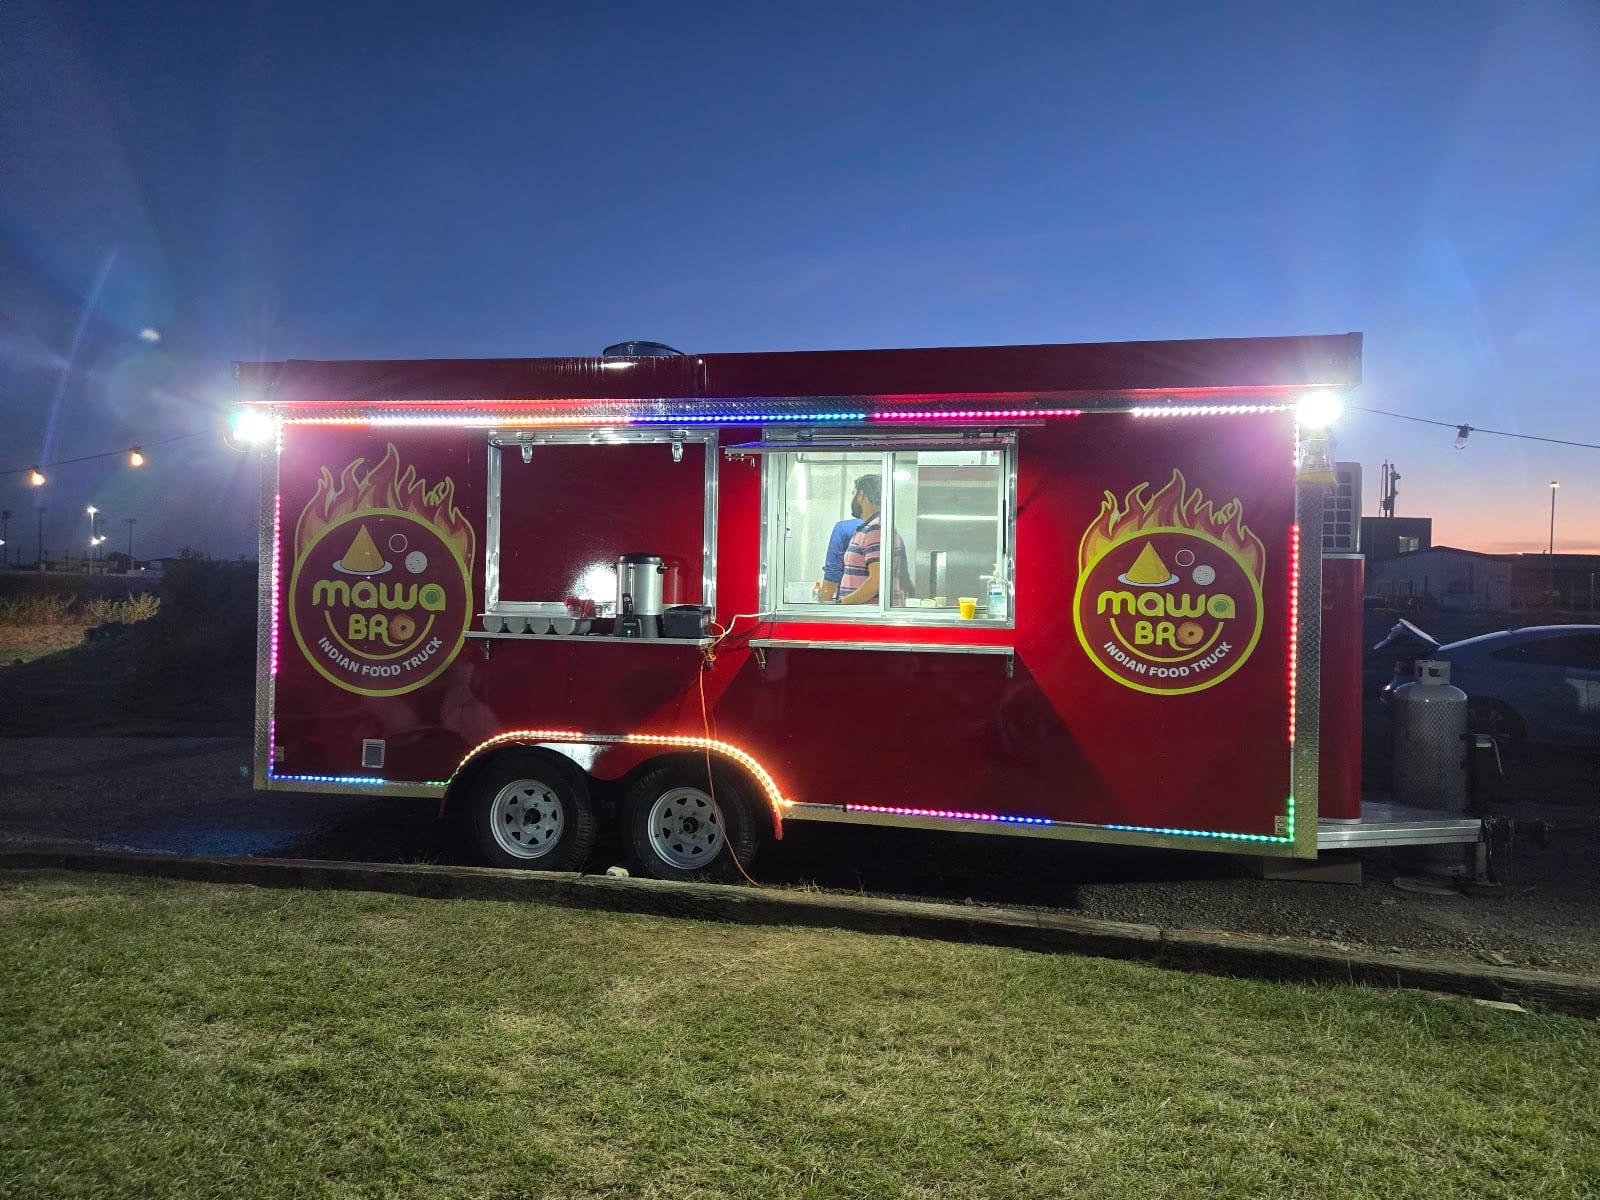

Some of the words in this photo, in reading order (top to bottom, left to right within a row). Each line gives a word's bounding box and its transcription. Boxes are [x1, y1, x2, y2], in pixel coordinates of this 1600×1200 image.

[312, 579, 446, 611] mawa
[1097, 590, 1236, 619] mawa
[348, 613, 416, 647] BRO
[1134, 620, 1204, 651] BRO
[317, 636, 359, 672] INDIAN
[361, 663, 401, 677] FOOD
[402, 636, 443, 671] TRUCK
[1103, 641, 1147, 674] INDIAN
[1149, 666, 1190, 678] FOOD
[1191, 641, 1233, 673] TRUCK
